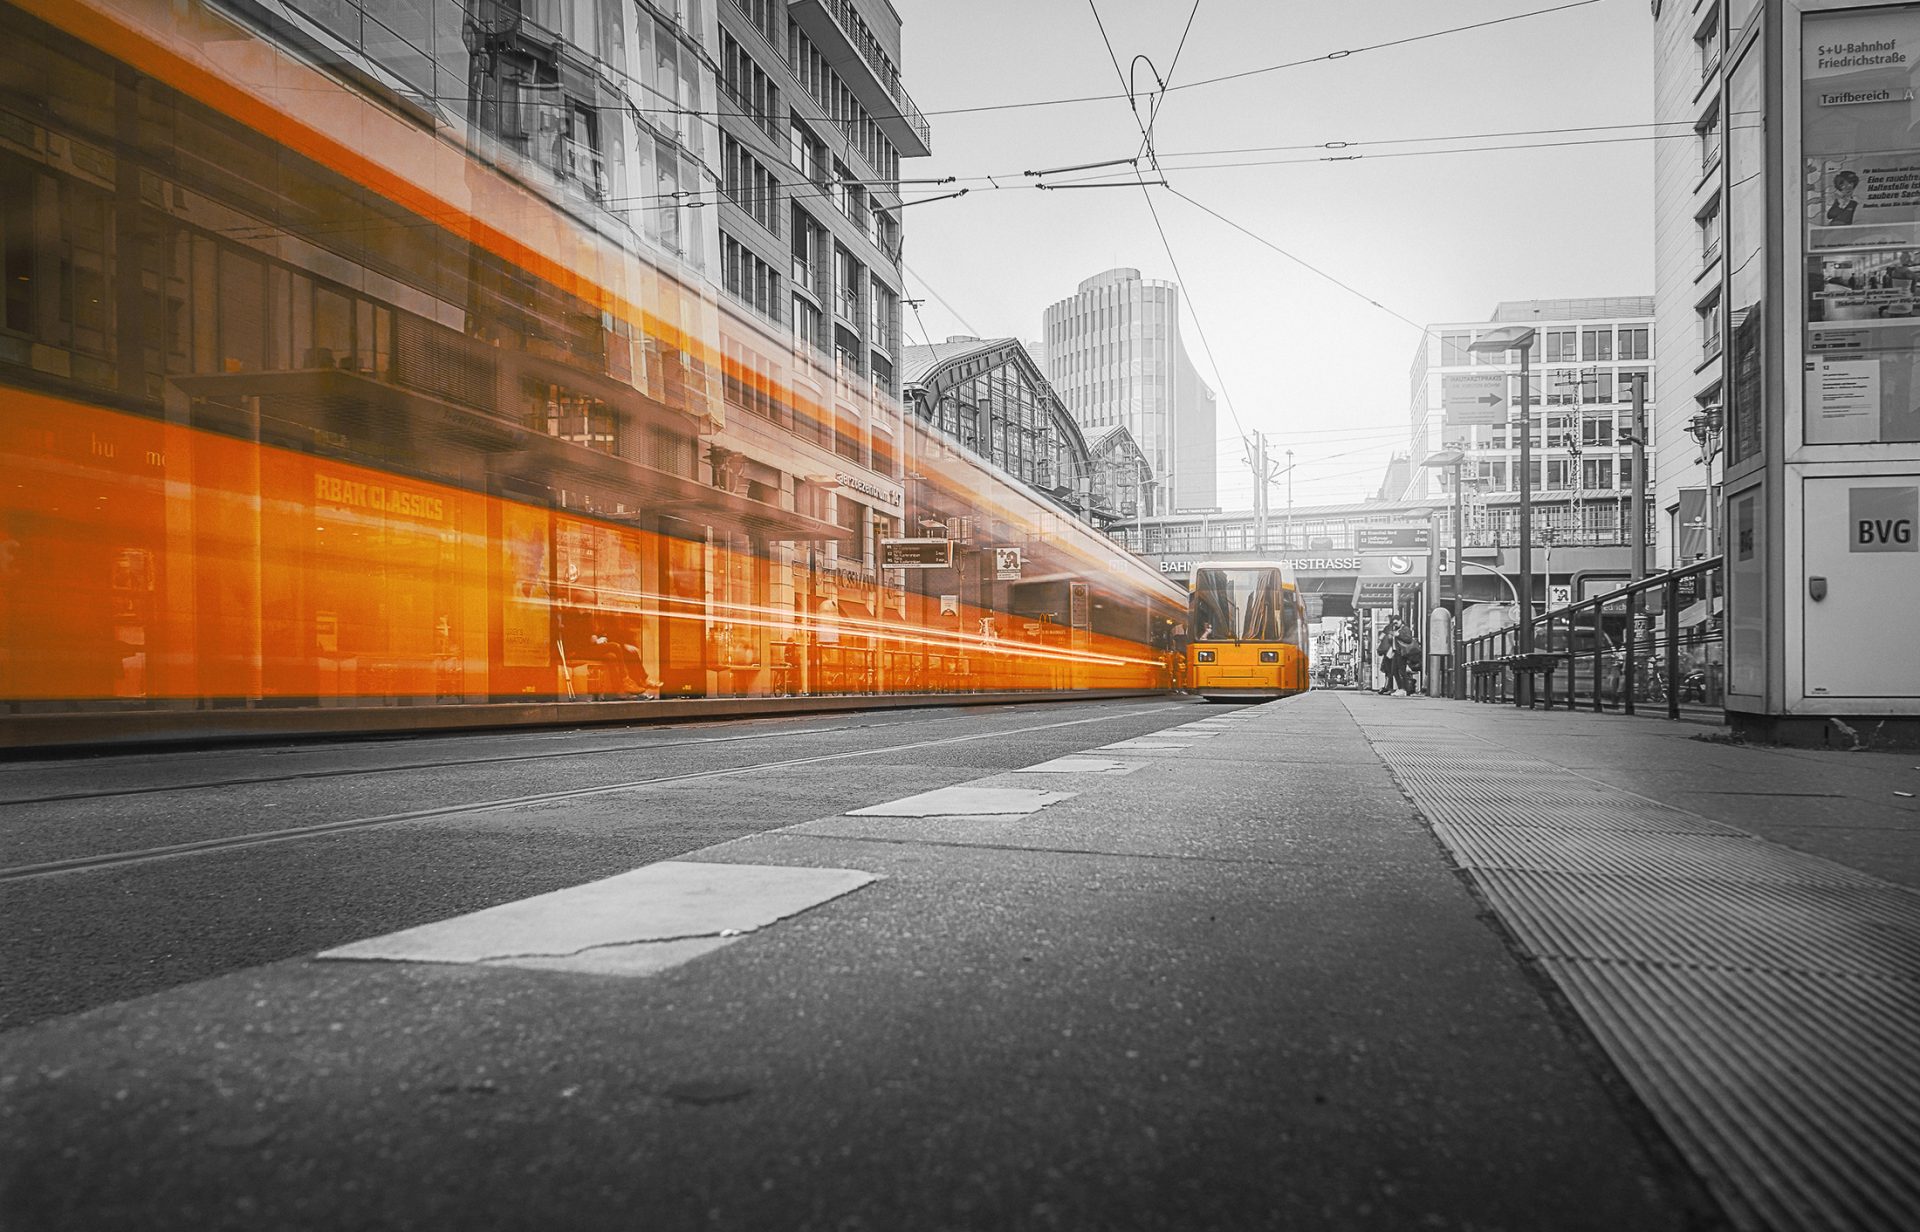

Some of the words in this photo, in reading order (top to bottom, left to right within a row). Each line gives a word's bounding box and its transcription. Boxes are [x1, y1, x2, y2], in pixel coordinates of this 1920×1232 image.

[1818, 39, 1896, 56] S+U-Bahnhof
[1818, 52, 1906, 69] Friedrichstraße
[1822, 90, 1889, 104] Tarifbereich
[367, 485, 443, 521] CLASSICS
[1859, 519, 1911, 544] BVG
